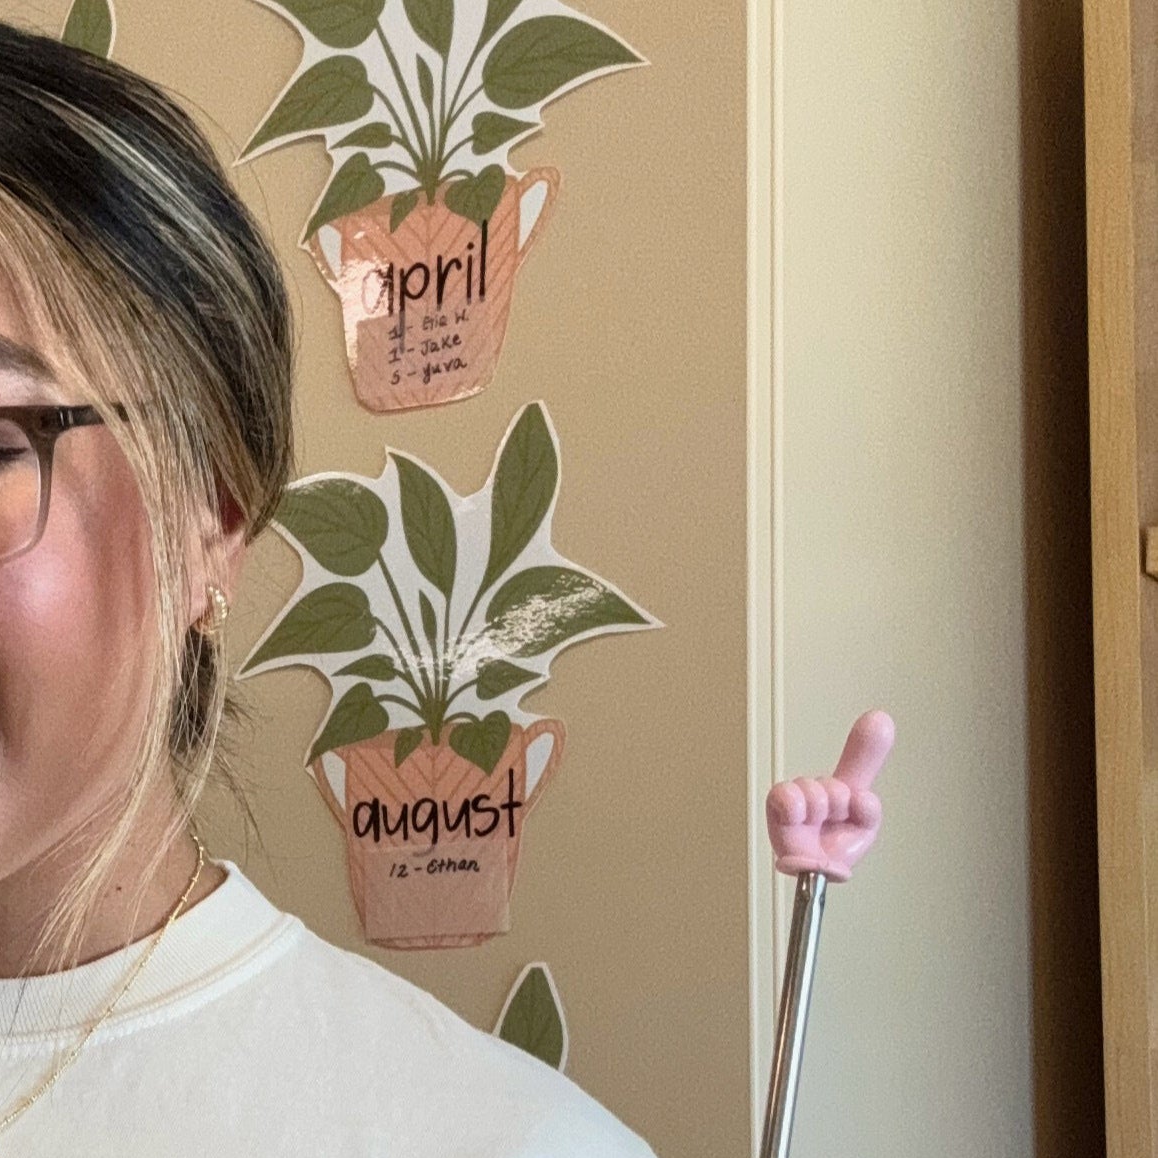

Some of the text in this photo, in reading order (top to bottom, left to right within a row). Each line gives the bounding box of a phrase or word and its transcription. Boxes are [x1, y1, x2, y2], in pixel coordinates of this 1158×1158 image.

[361, 219, 488, 353] april
[388, 347, 402, 364] 1
[353, 768, 523, 856] august
[389, 863, 409, 878] 12
[426, 857, 480, 875] Ethan
